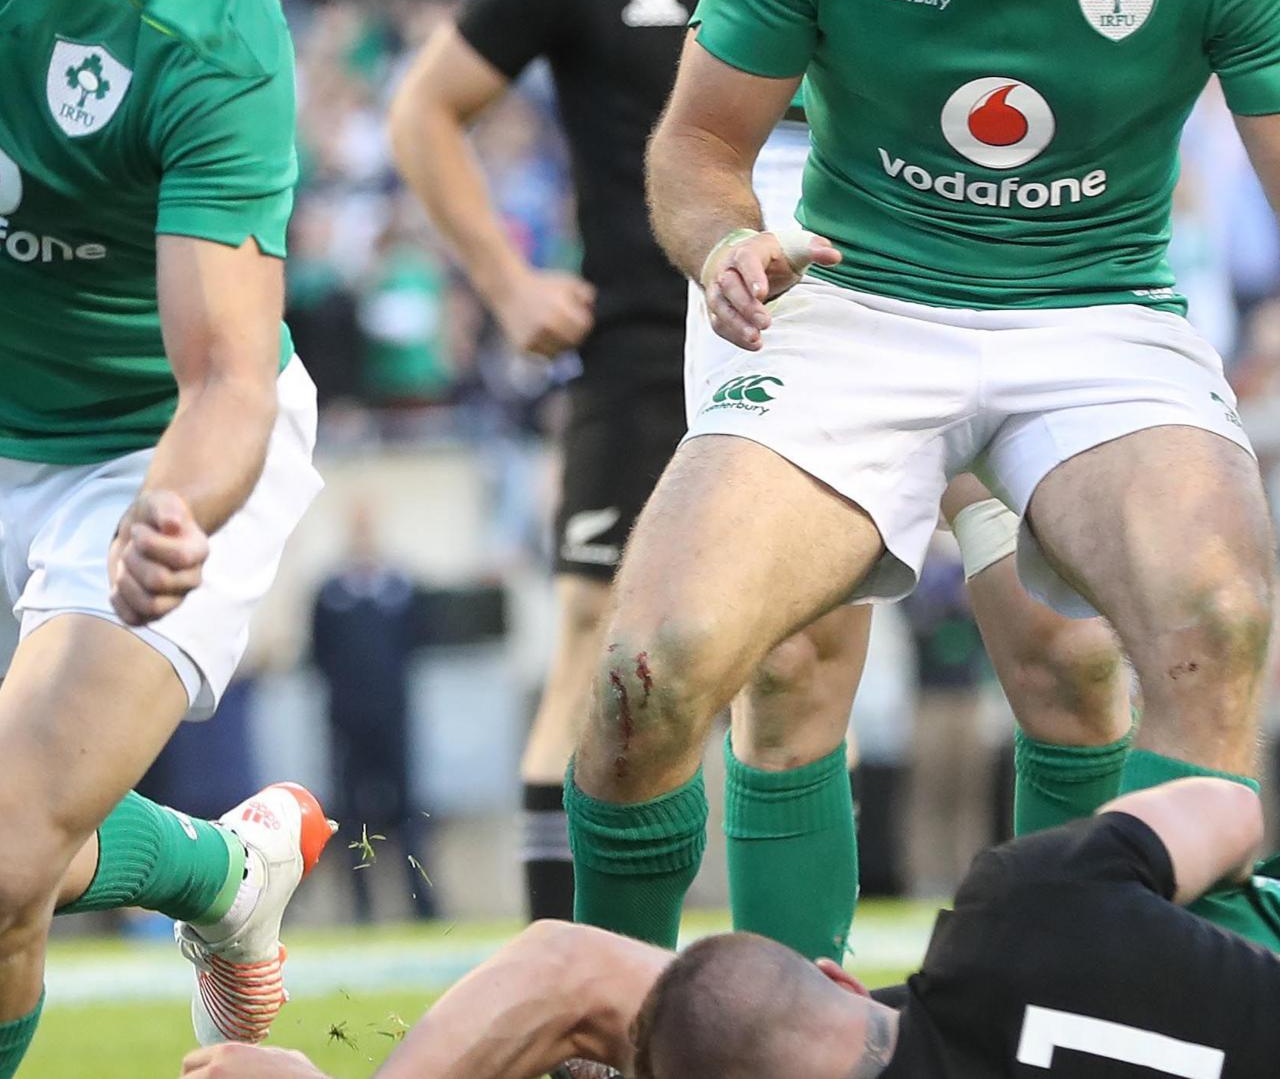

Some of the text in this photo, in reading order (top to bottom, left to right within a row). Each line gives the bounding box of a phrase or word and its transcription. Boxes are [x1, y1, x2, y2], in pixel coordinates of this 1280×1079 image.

[1099, 14, 1136, 28] IRFU
[58, 101, 95, 128] IRFU
[877, 146, 1108, 210] vodafone
